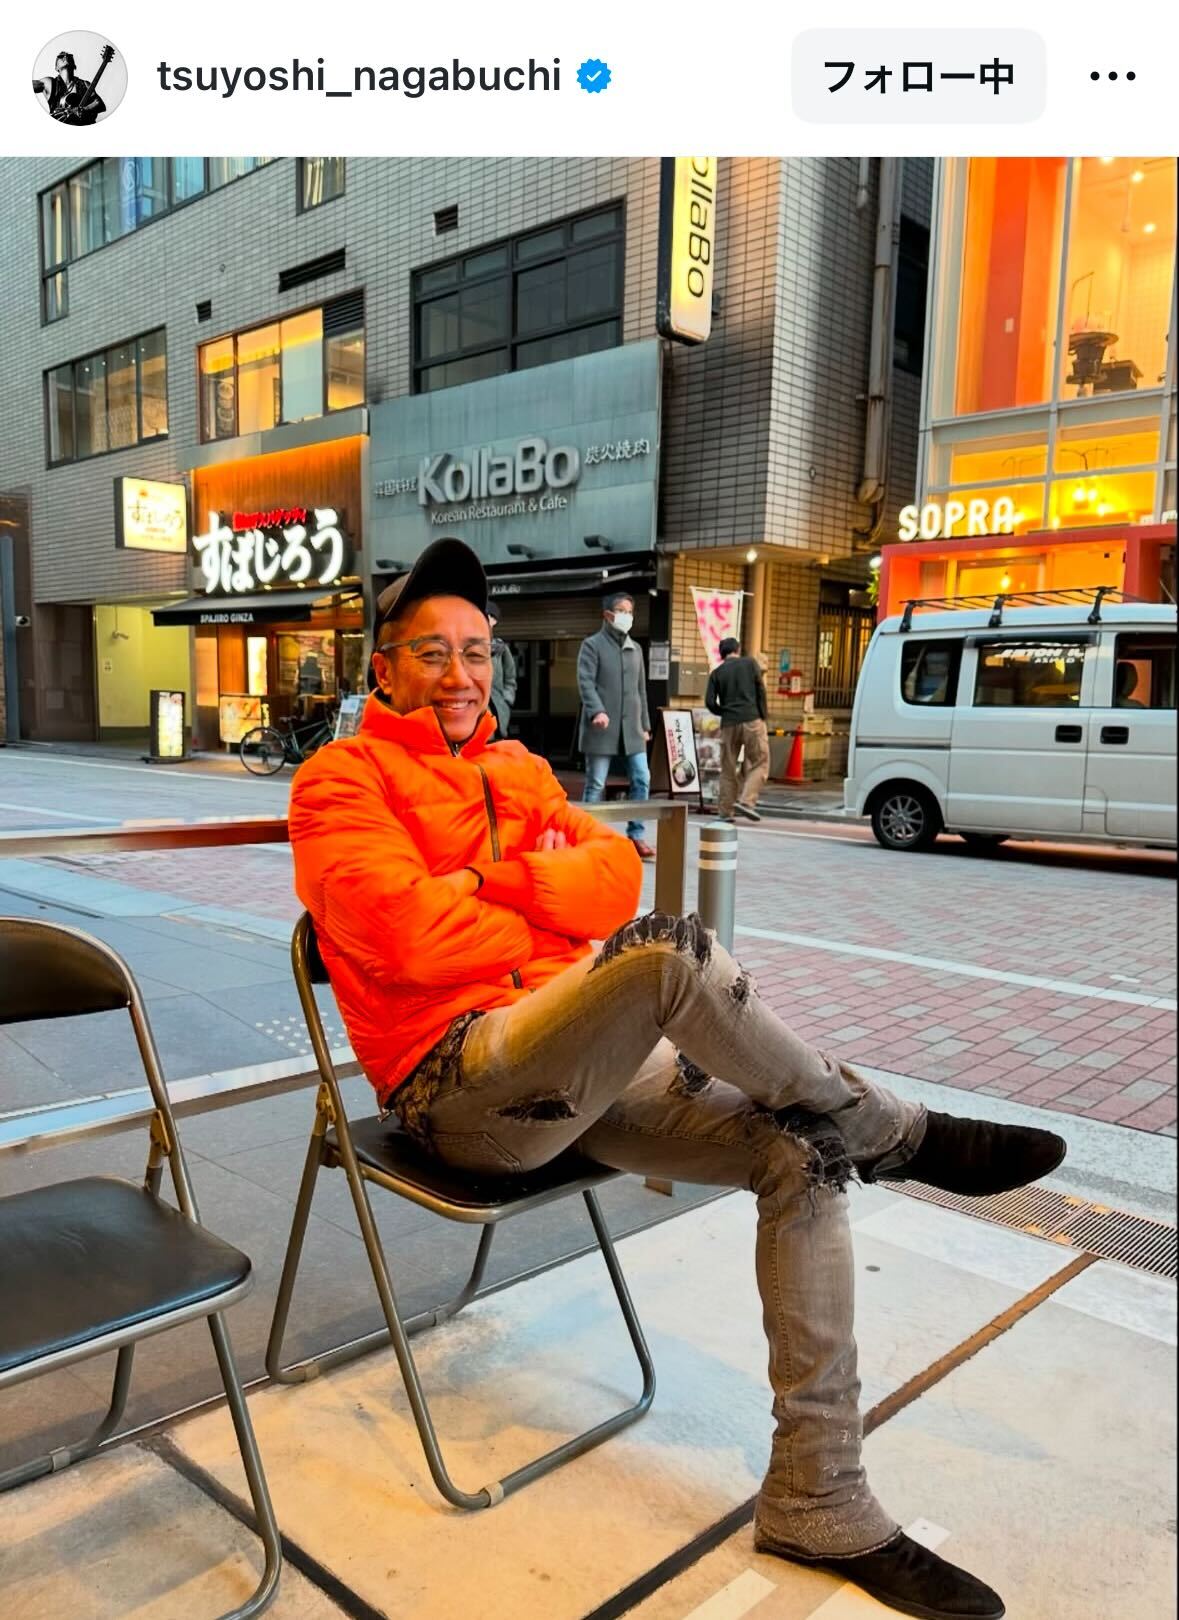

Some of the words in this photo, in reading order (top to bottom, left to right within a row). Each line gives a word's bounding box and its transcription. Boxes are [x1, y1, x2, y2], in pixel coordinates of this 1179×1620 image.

[585, 438, 651, 465] 炭火焼肉
[418, 437, 580, 506] KollaBo
[431, 509, 467, 525] Korean
[468, 500, 526, 520] Restaurant
[528, 498, 538, 512] &
[540, 494, 568, 510] Cafe
[898, 496, 1016, 542] SOPRA
[200, 613, 229, 624] SPAJIRO
[230, 612, 255, 623] GINZA
